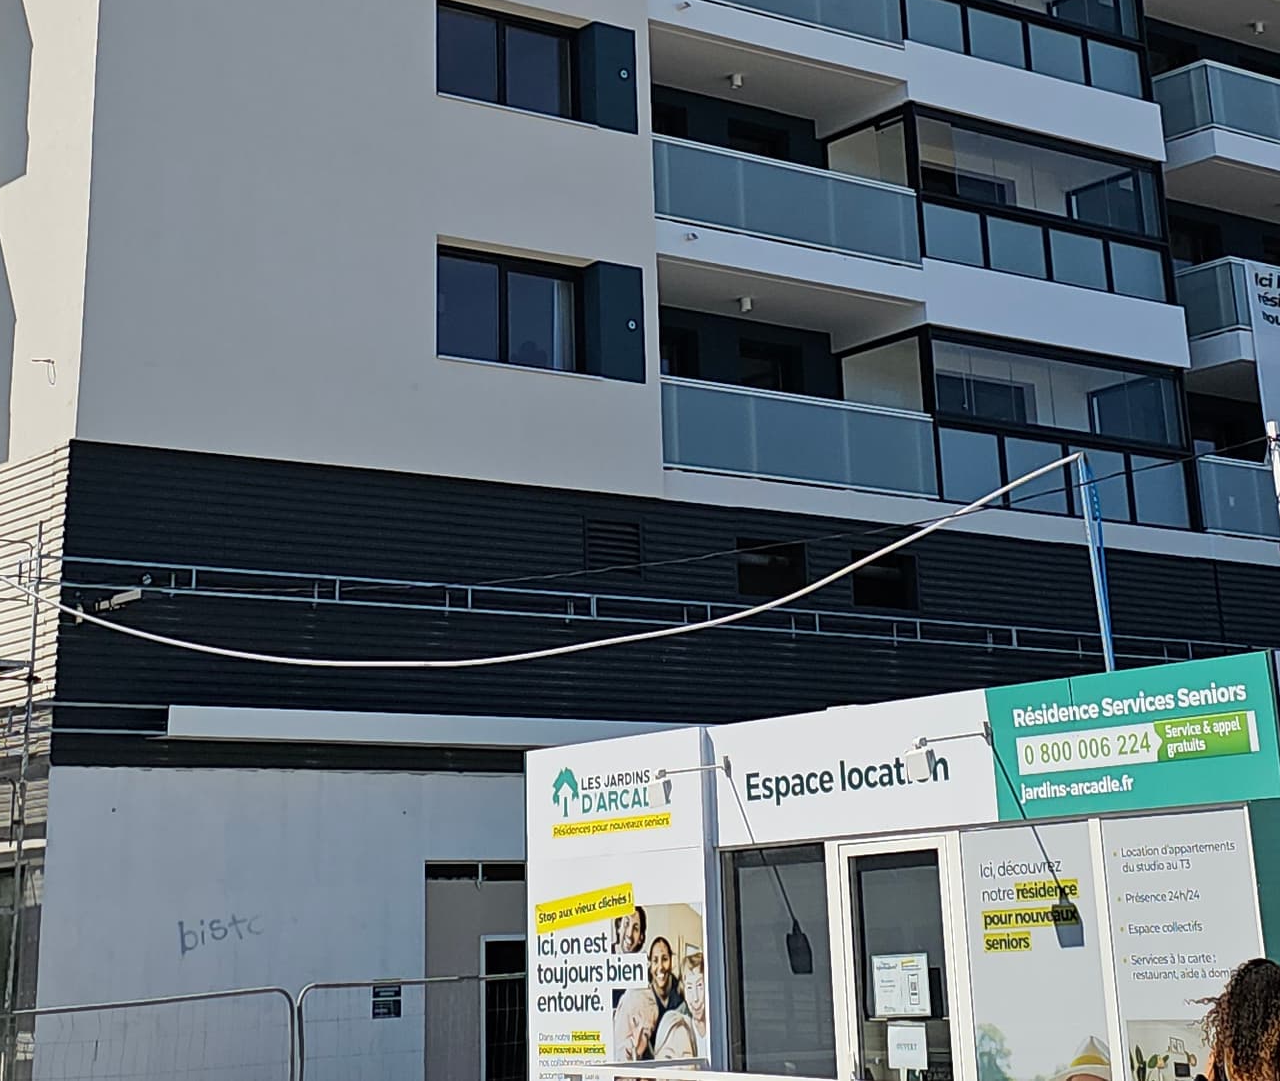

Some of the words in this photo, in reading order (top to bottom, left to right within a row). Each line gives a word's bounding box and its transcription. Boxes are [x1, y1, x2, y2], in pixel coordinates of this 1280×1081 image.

[1255, 272, 1273, 288] Ici
[1013, 701, 1099, 727] Résidence
[1102, 690, 1175, 717] Services
[1177, 682, 1247, 708] Seniors
[1165, 723, 1201, 738] Service
[1203, 722, 1211, 734] &
[1212, 716, 1241, 735] appel
[1024, 744, 1034, 765] 0
[1040, 740, 1071, 763] 800
[1078, 737, 1111, 759] 006
[1116, 732, 1151, 756] 224
[1167, 738, 1206, 758] gratuits
[581, 776, 601, 791] LES
[603, 769, 650, 788] JARDINS
[746, 770, 834, 806] Espace
[839, 756, 949, 792] locatn
[1021, 774, 1134, 805] jardins-arcadie.fr
[1121, 845, 1159, 858] Location
[1161, 841, 1236, 856] d'appartements
[980, 862, 996, 879] Ici,
[997, 860, 1062, 877] découvrez
[1123, 863, 1135, 873] du
[1136, 860, 1165, 873] studio
[1166, 861, 1178, 871] au
[1180, 859, 1191, 870] T3
[982, 887, 1015, 902] notre
[1016, 882, 1078, 900] résidence
[1125, 891, 1167, 904] Présence
[1168, 888, 1200, 902] 24h/24
[538, 911, 556, 924] Stop
[558, 907, 573, 920] aux
[575, 899, 596, 915] vieux
[983, 913, 1013, 930] pour
[1015, 908, 1078, 925] nouveaux
[1128, 922, 1160, 936] Espace
[1162, 920, 1203, 933] collectifs
[537, 933, 558, 958] Ici,
[560, 936, 580, 954] on
[584, 932, 608, 953] est
[985, 933, 1030, 951] seniors
[1131, 953, 1168, 966] Services
[1170, 953, 1176, 964] à
[1177, 953, 1186, 964] la
[537, 959, 604, 989] toujours
[607, 957, 644, 981] bien
[1180, 968, 1199, 979] aide
[537, 988, 605, 1012] entouré.
